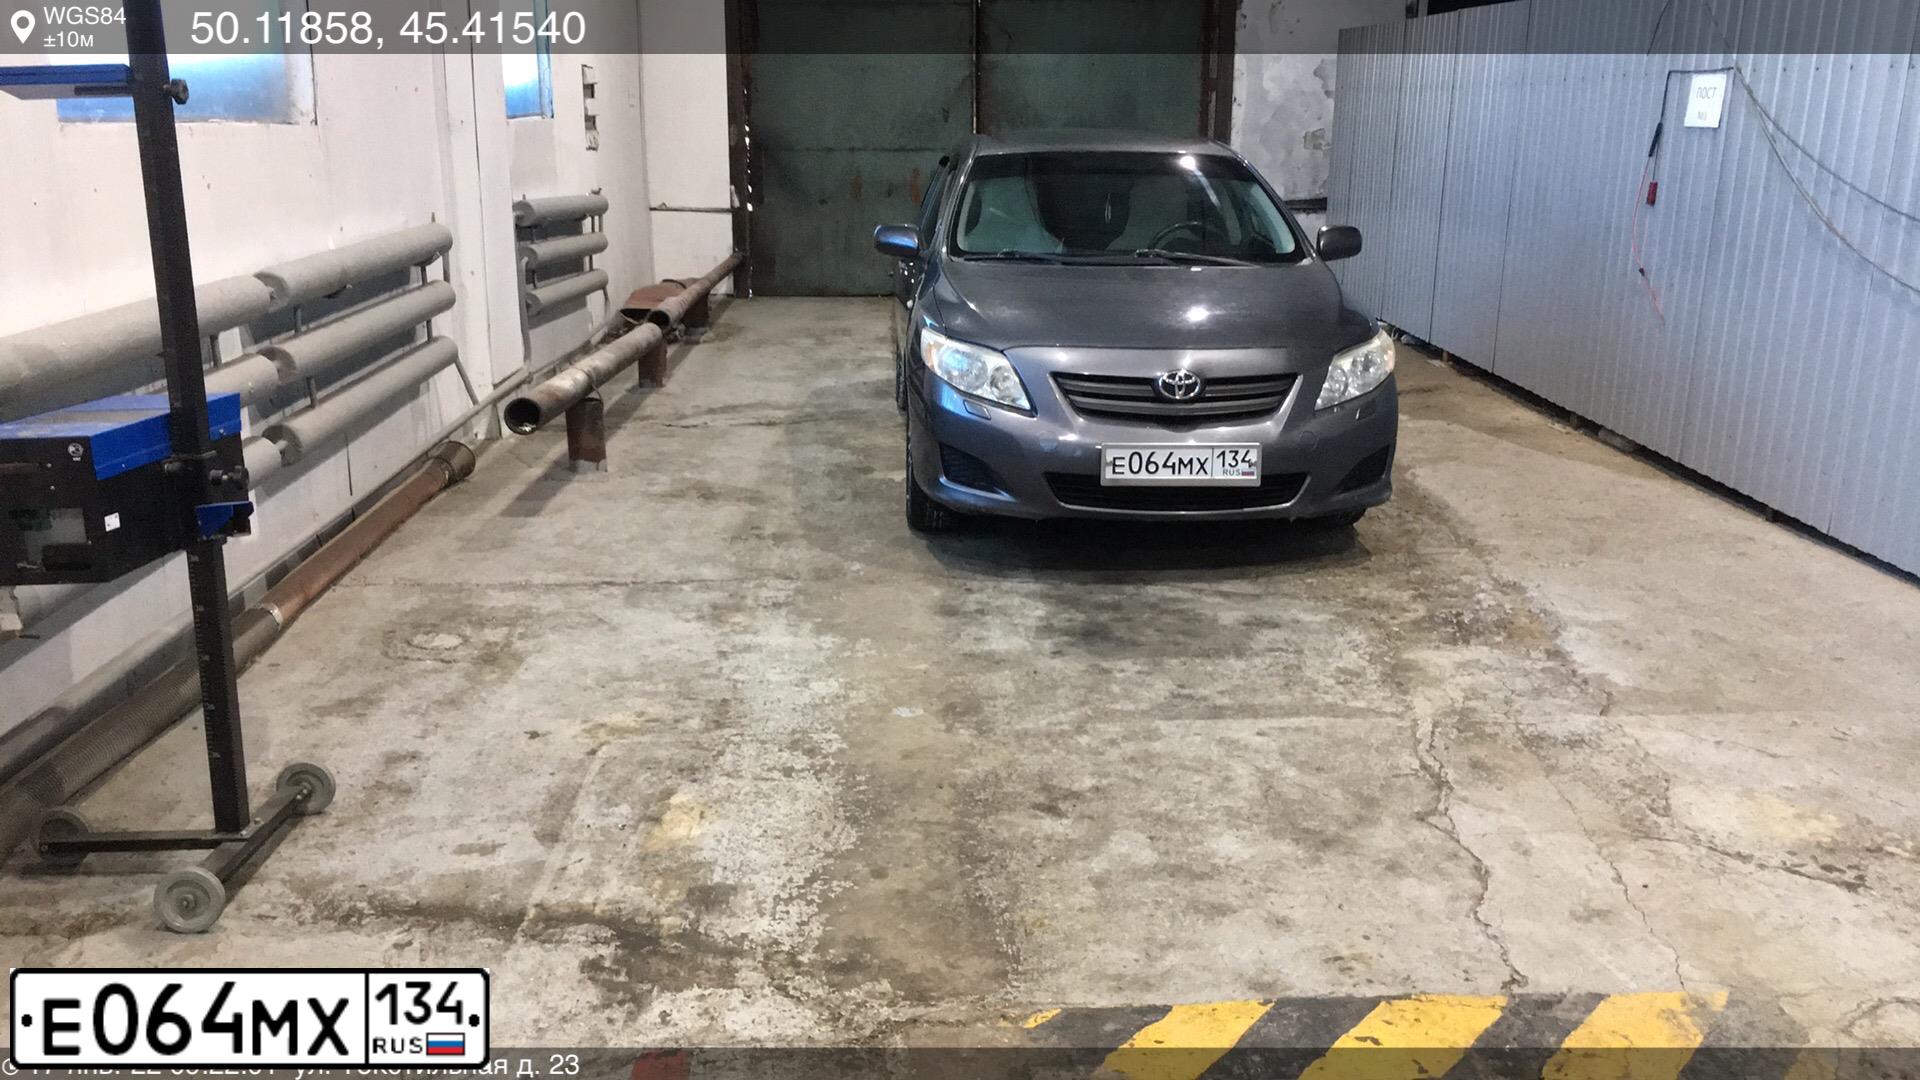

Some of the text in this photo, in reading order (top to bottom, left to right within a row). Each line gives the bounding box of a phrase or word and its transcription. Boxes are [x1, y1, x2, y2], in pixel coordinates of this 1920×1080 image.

[1696, 86, 1718, 100] ПОСТ
[1216, 449, 1252, 468] 134
[1222, 468, 1241, 477] RUS
